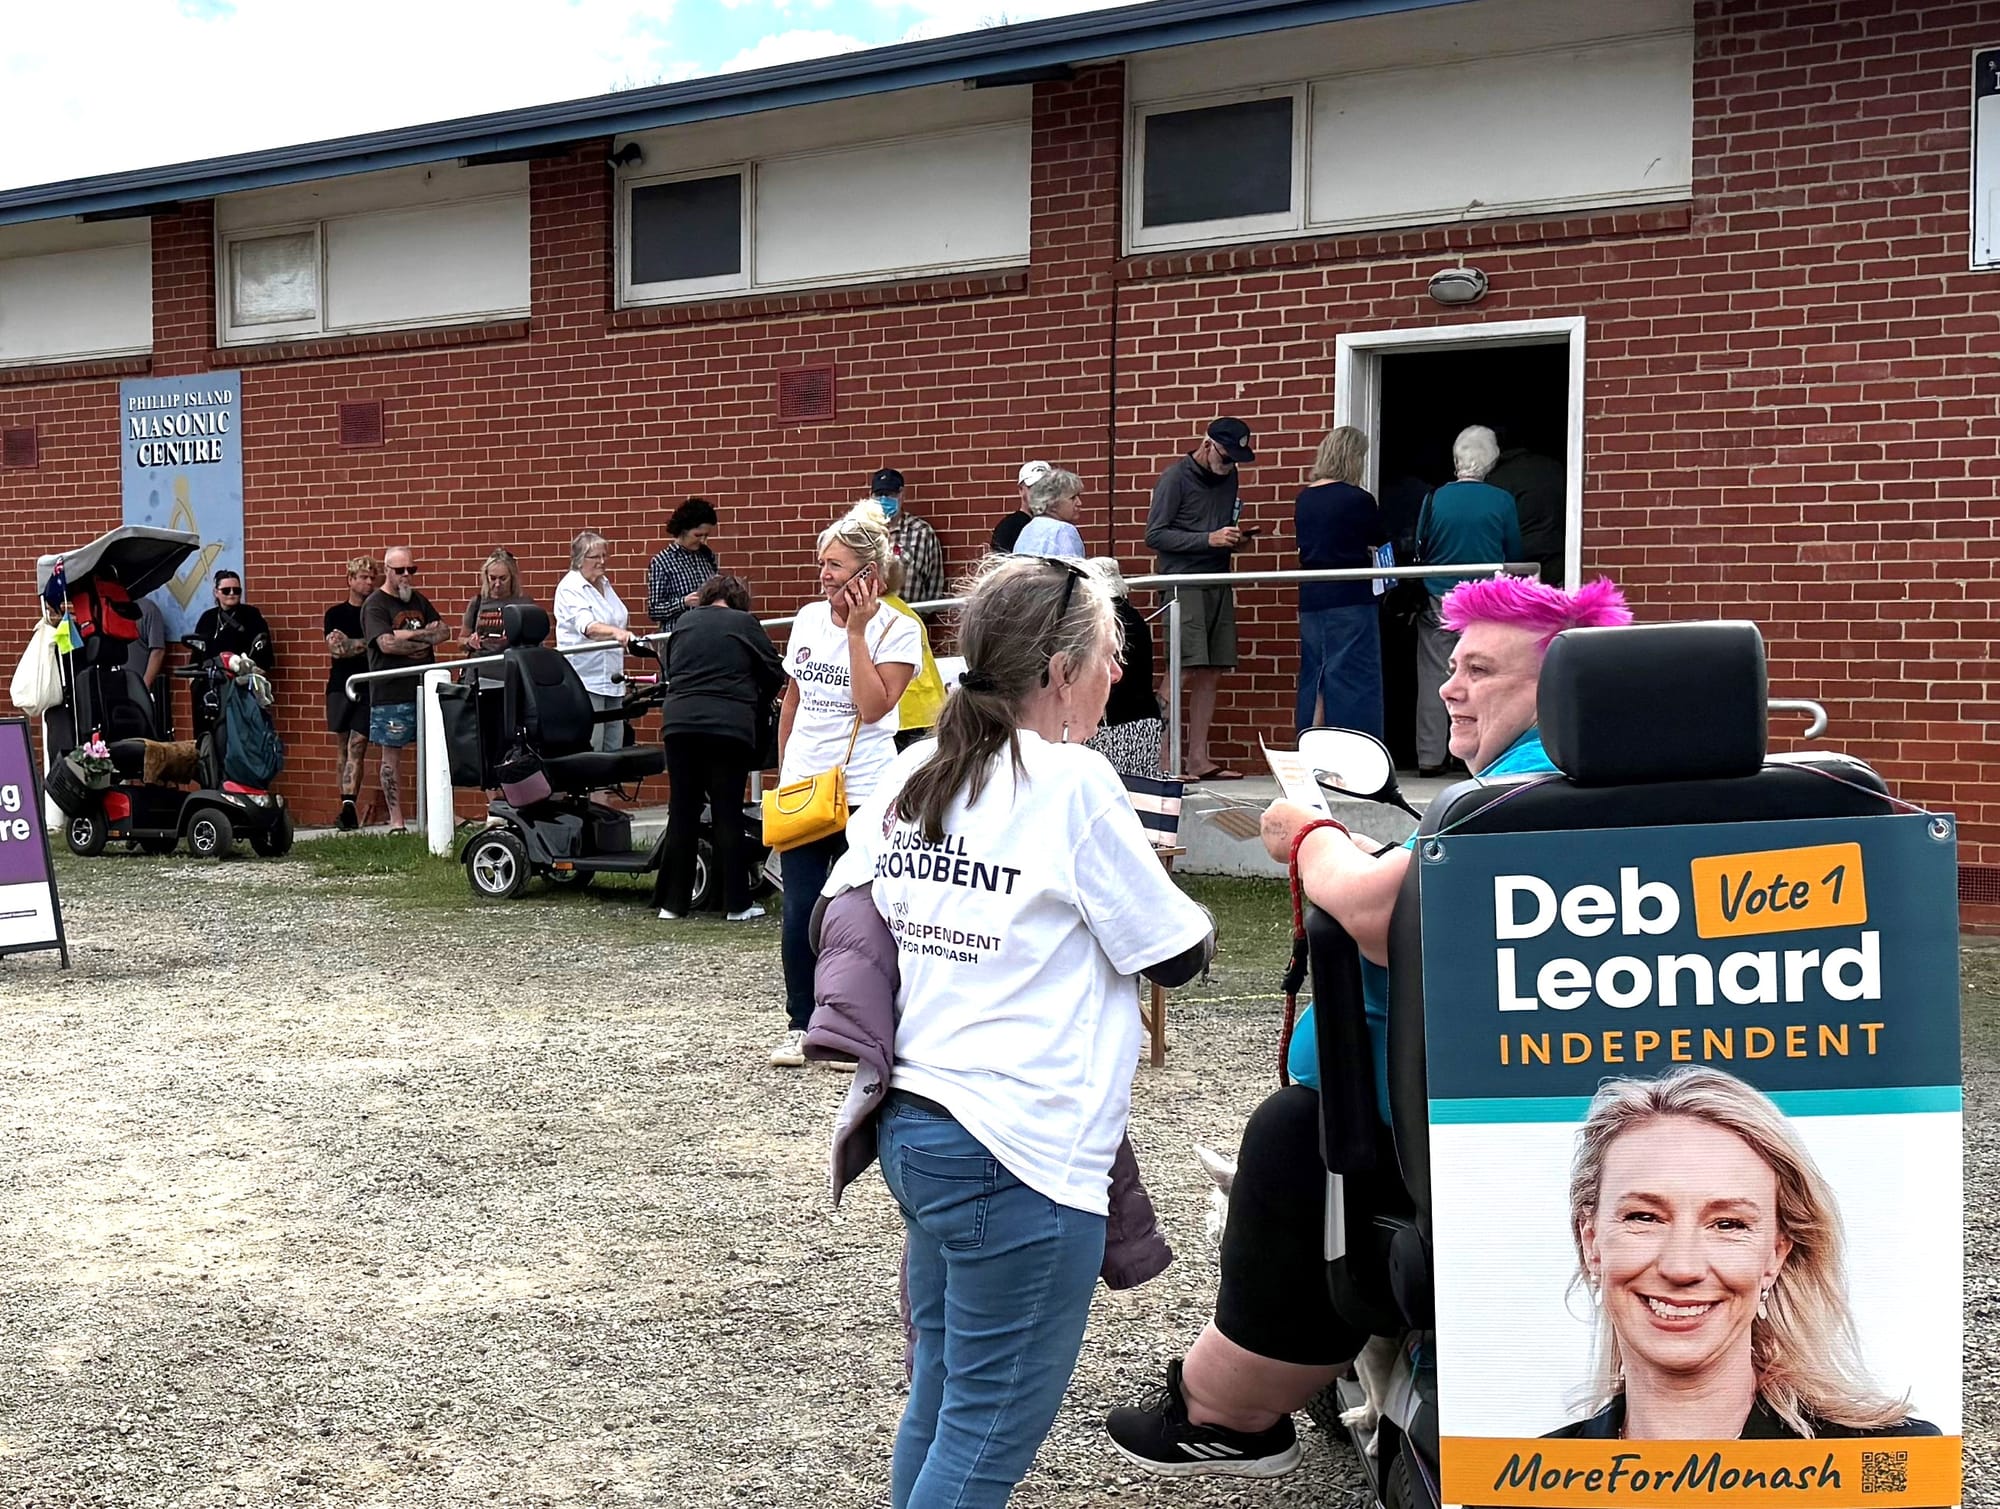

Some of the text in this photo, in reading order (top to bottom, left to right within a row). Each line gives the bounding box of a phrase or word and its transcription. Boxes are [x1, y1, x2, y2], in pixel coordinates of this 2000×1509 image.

[128, 389, 232, 412] PHILLIP ISLAND
[129, 410, 231, 440] MASONIC
[137, 438, 224, 467] CENTRE
[793, 669, 851, 687] ROADBE
[1494, 866, 1681, 940] Deb
[1720, 864, 1846, 922] Vote 1
[903, 940, 919, 955] FOR
[922, 944, 978, 964] MONASH
[1496, 930, 1882, 1012] Leonard
[1499, 1022, 1885, 1066] INDEPENDENT
[1493, 1450, 1842, 1493] MoreForMonash
